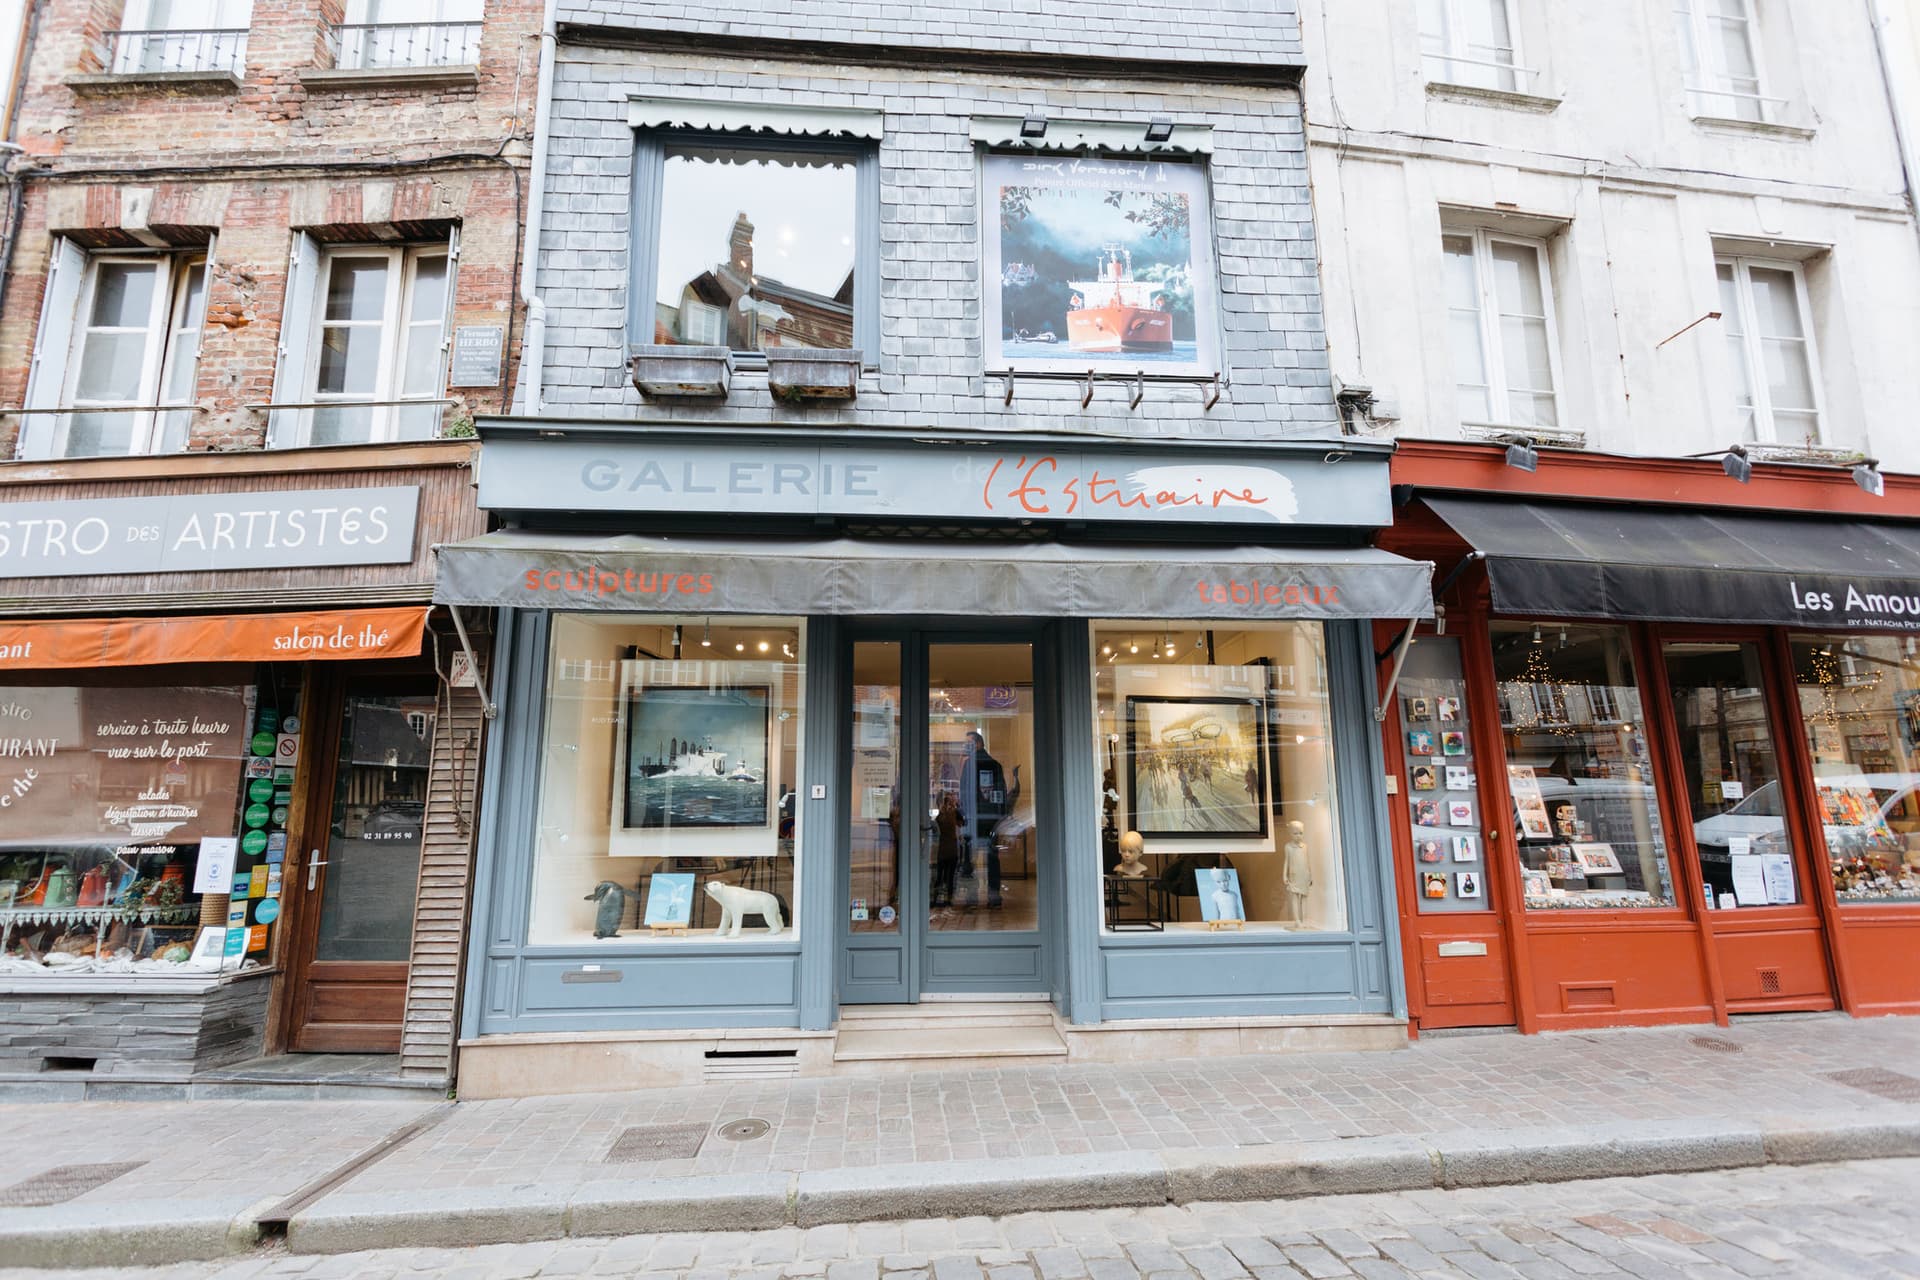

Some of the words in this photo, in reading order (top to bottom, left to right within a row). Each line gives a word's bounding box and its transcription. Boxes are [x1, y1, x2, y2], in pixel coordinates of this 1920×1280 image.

[581, 458, 879, 496] GALERIE
[127, 526, 160, 542] DES
[173, 506, 390, 551] ARTISTES
[524, 566, 714, 598] sculptures
[1197, 578, 1340, 605] tableaux
[1790, 581, 1834, 611] Les
[272, 625, 324, 650] salon
[329, 624, 354, 649] de
[359, 622, 389, 647] thé
[1864, 619, 1904, 628] NATACHA
[97, 720, 139, 736] service
[141, 719, 151, 735] à
[152, 719, 189, 735] toute
[191, 716, 230, 734] heure
[107, 746, 131, 759] vue
[133, 744, 158, 759] sur
[160, 740, 176, 758] le
[176, 741, 213, 765] port
[138, 786, 170, 800] salades
[131, 823, 164, 836] desserts
[364, 832, 372, 840] 02
[374, 832, 382, 840] 31
